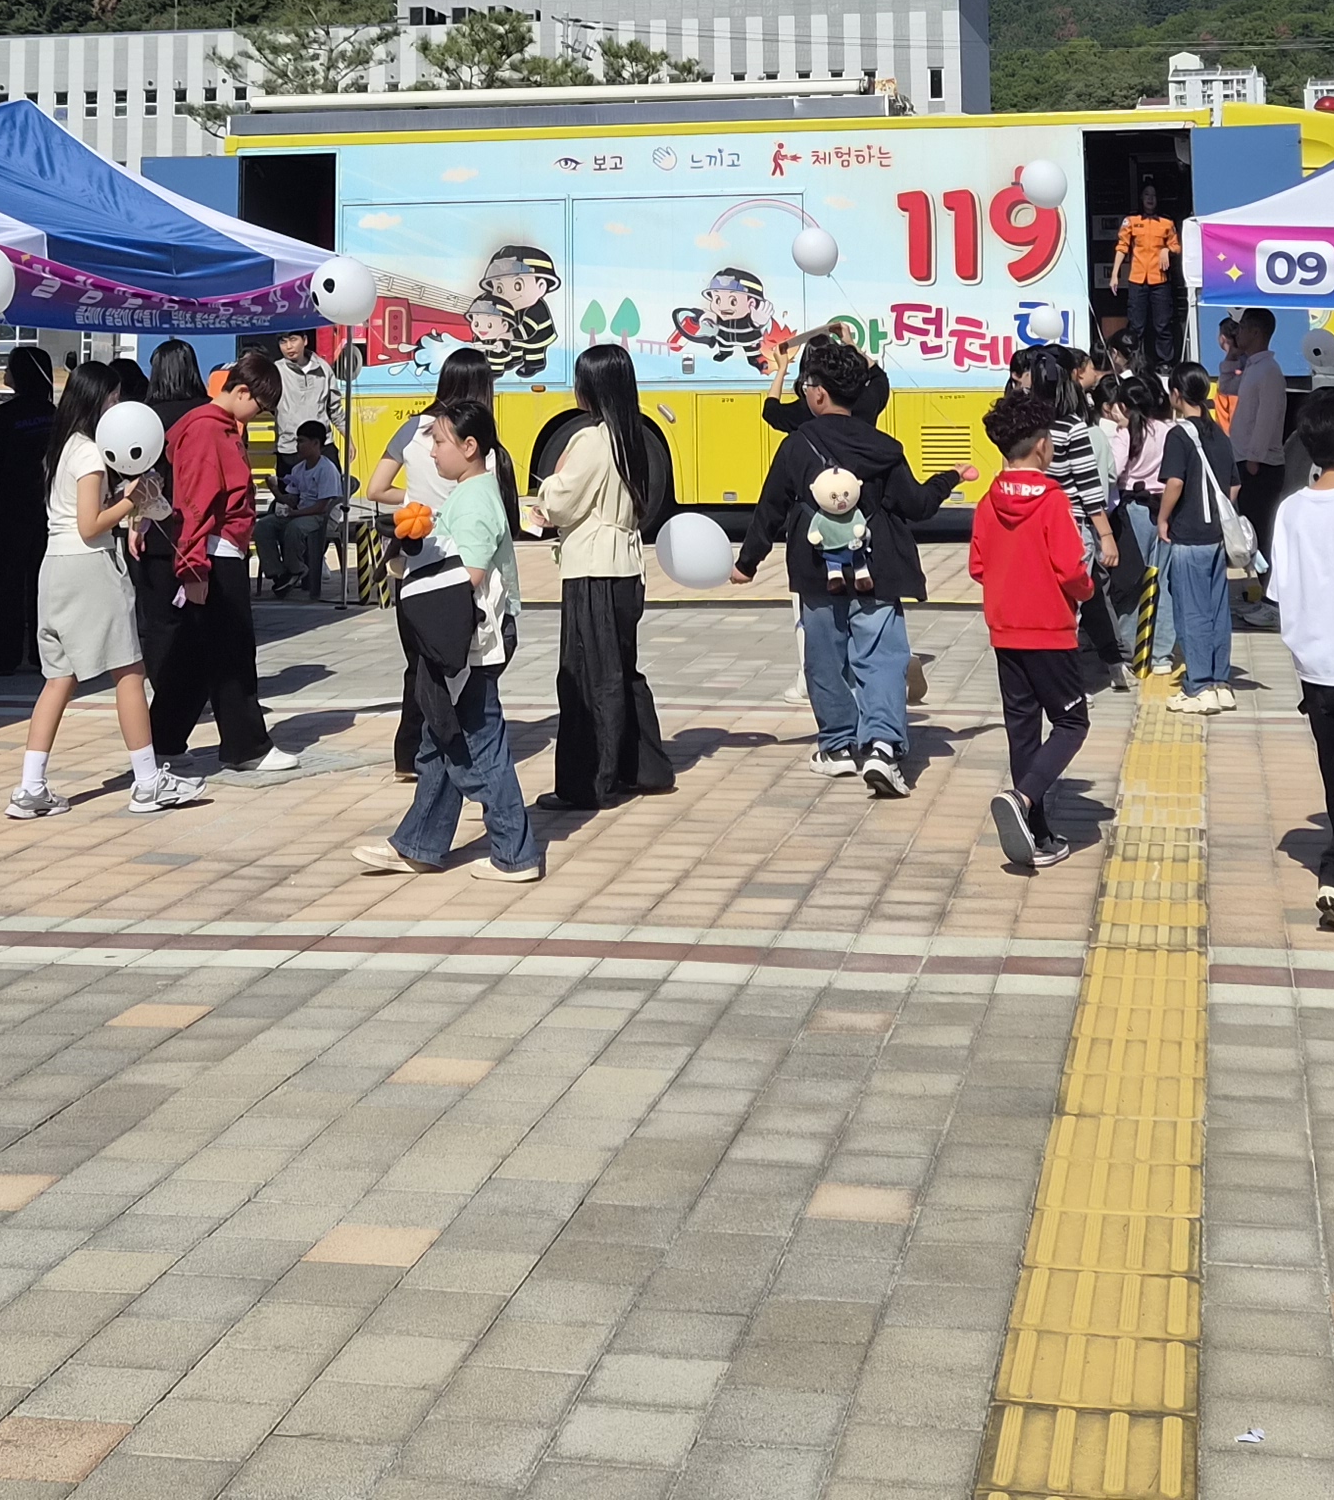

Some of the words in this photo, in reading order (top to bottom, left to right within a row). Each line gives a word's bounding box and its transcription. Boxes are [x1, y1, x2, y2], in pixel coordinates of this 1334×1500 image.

[592, 154, 625, 172] 보고
[690, 147, 742, 169] 느끼고
[811, 145, 893, 169] 체험하는
[896, 188, 1067, 287] 119
[1265, 250, 1328, 287] 09
